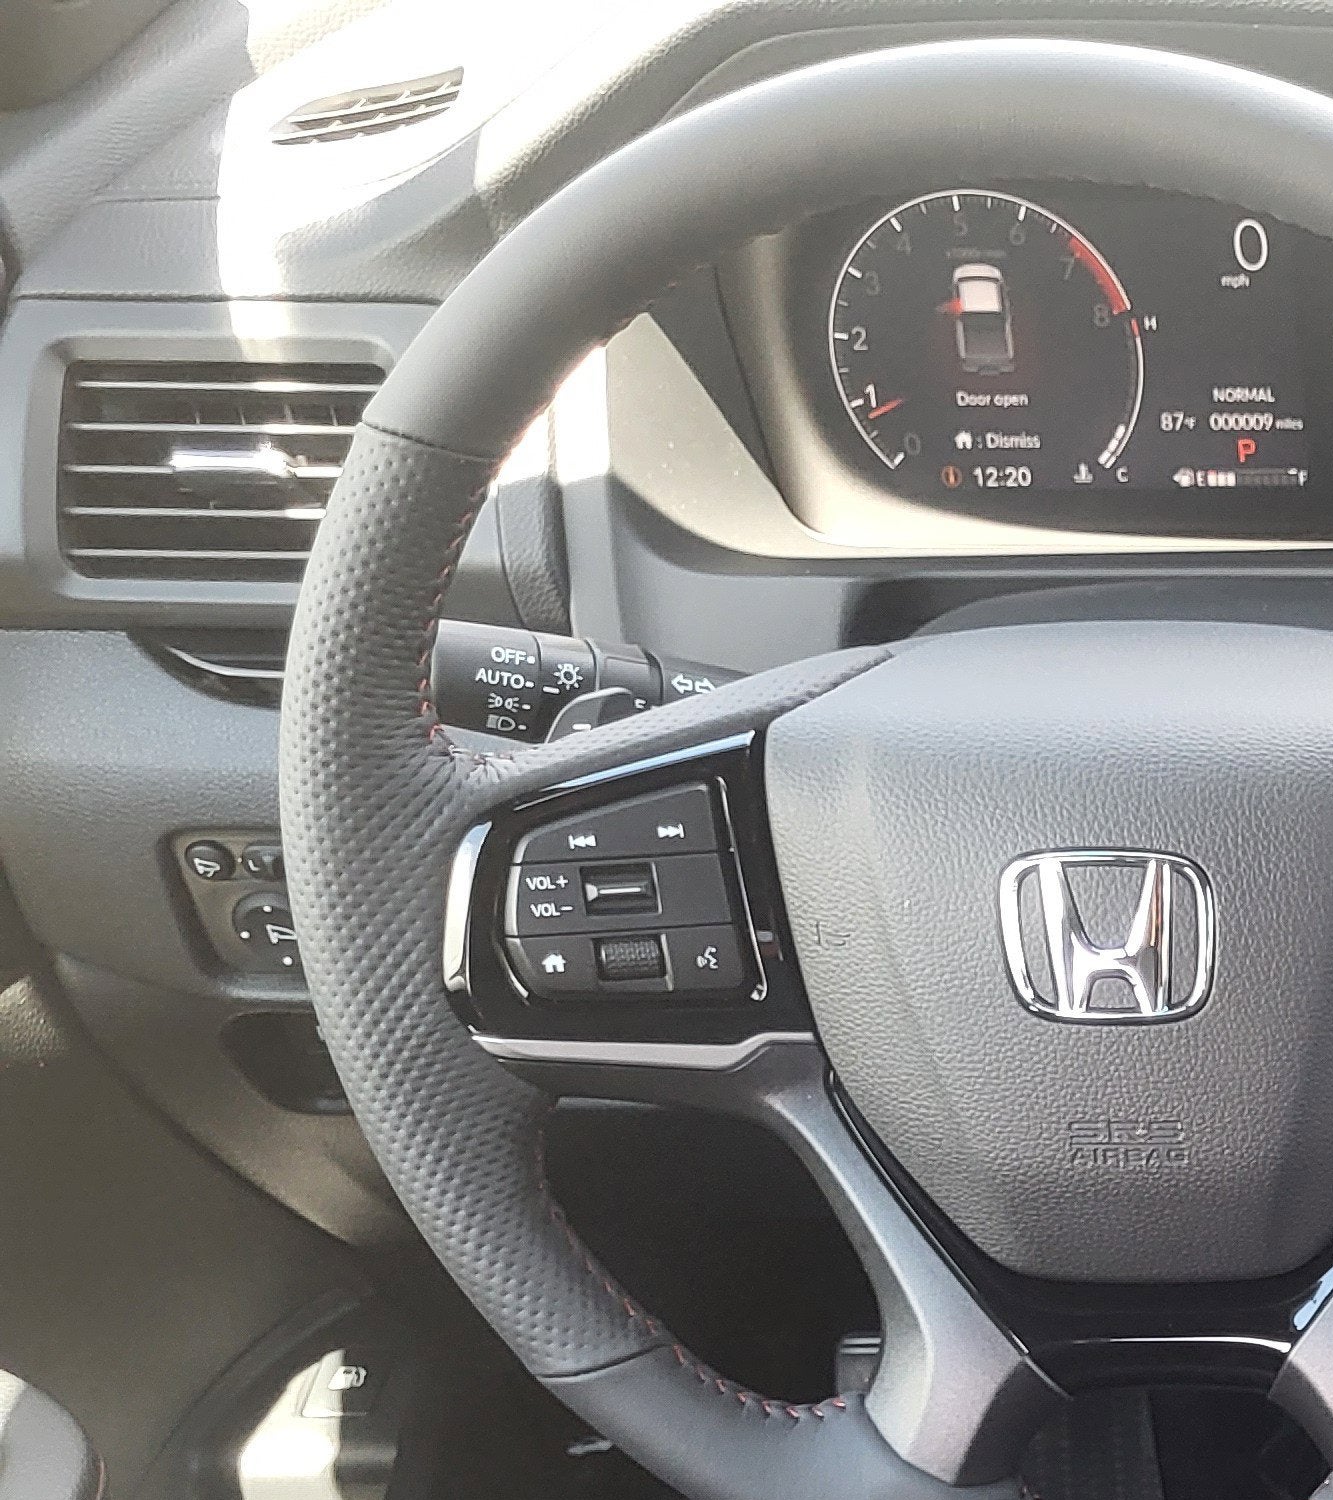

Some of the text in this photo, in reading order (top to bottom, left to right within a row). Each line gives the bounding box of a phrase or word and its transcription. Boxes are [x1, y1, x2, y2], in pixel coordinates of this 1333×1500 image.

[896, 230, 912, 254] 4
[1009, 221, 1026, 245] 6
[1232, 218, 1269, 272] 0
[864, 271, 880, 295] 3
[1221, 274, 1251, 290] mph
[1093, 304, 1110, 328] 8
[1143, 316, 1158, 331] H
[851, 327, 868, 351] 2
[863, 384, 877, 408] 1
[956, 391, 1029, 410] Door open
[1212, 387, 1275, 403] NORMAL
[1209, 411, 1274, 431] 000009
[905, 433, 921, 455] 0
[985, 432, 1041, 450] Dismiss
[1237, 438, 1257, 463] P
[972, 466, 1033, 488] 12:20
[491, 647, 528, 665] OFF
[476, 667, 526, 690] AUTO
